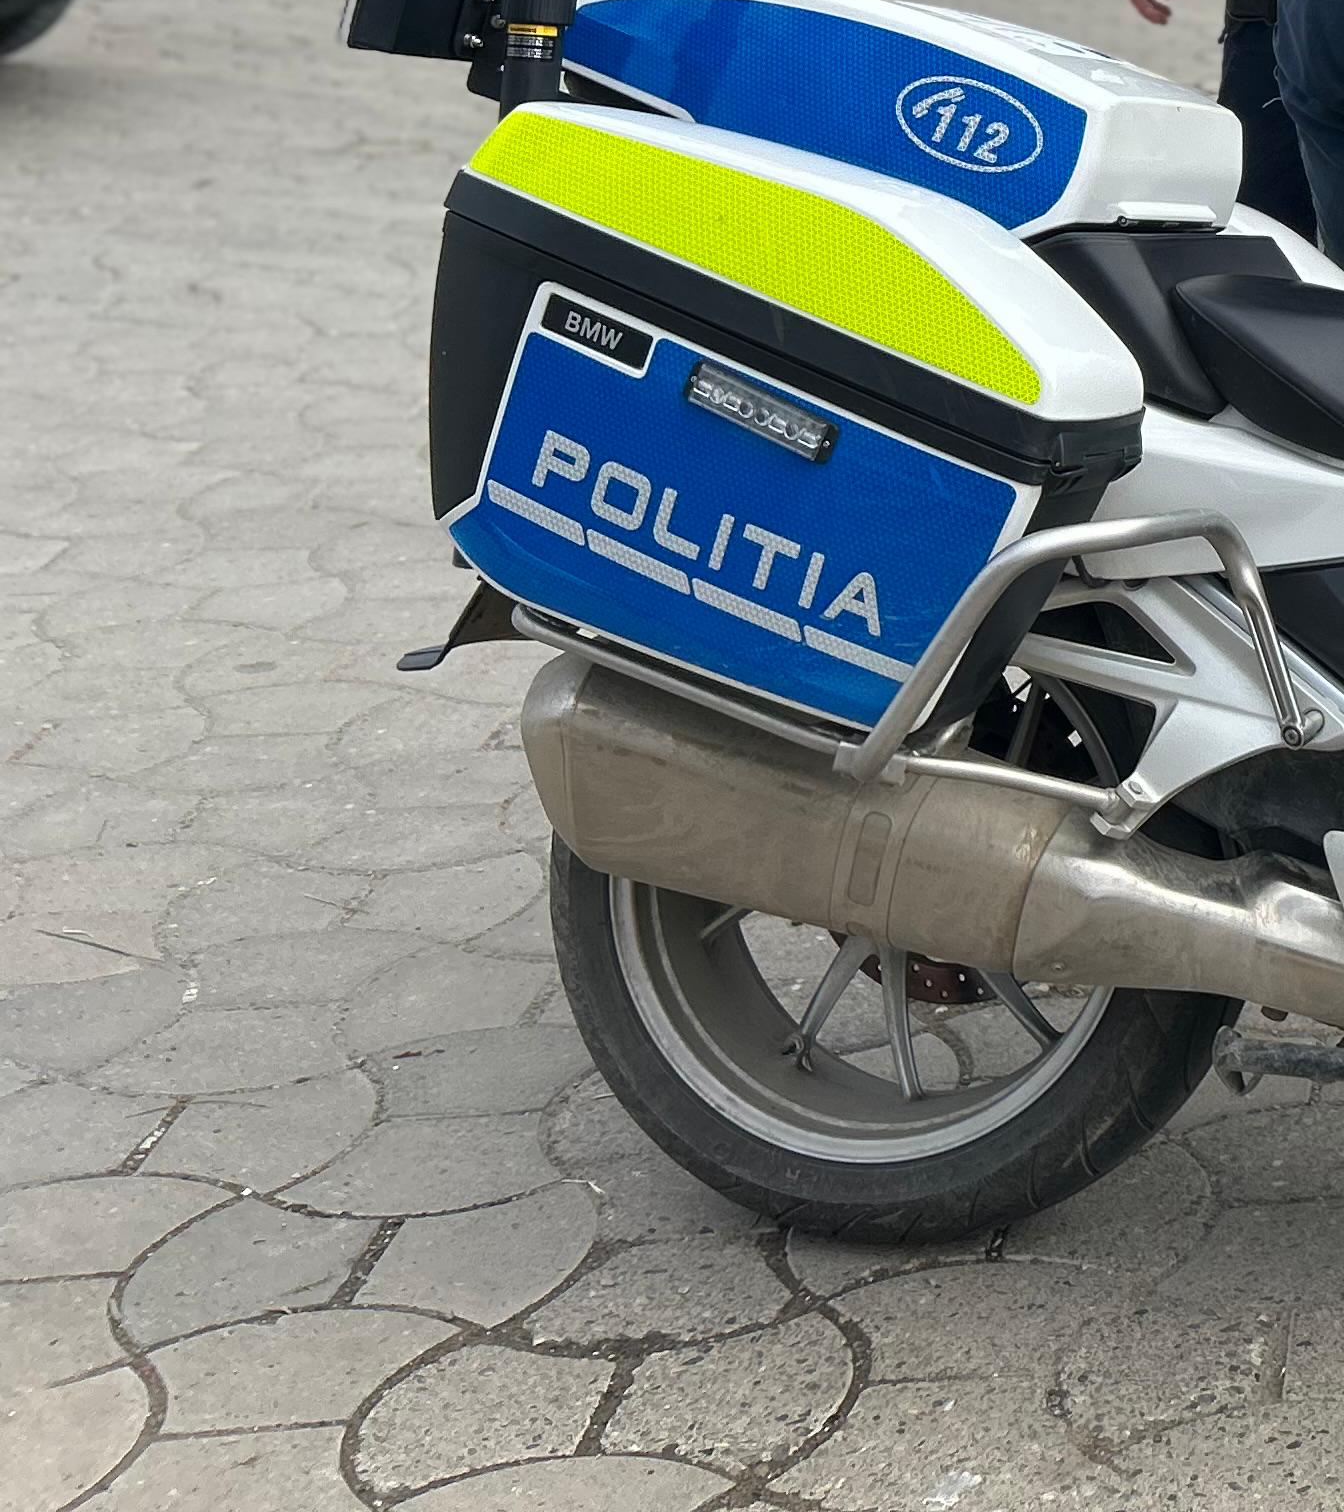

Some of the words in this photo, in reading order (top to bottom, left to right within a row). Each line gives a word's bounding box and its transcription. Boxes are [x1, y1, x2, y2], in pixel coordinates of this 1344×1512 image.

[931, 103, 1010, 163] 112
[564, 310, 624, 350] BMW
[531, 429, 884, 638] POLITIA
